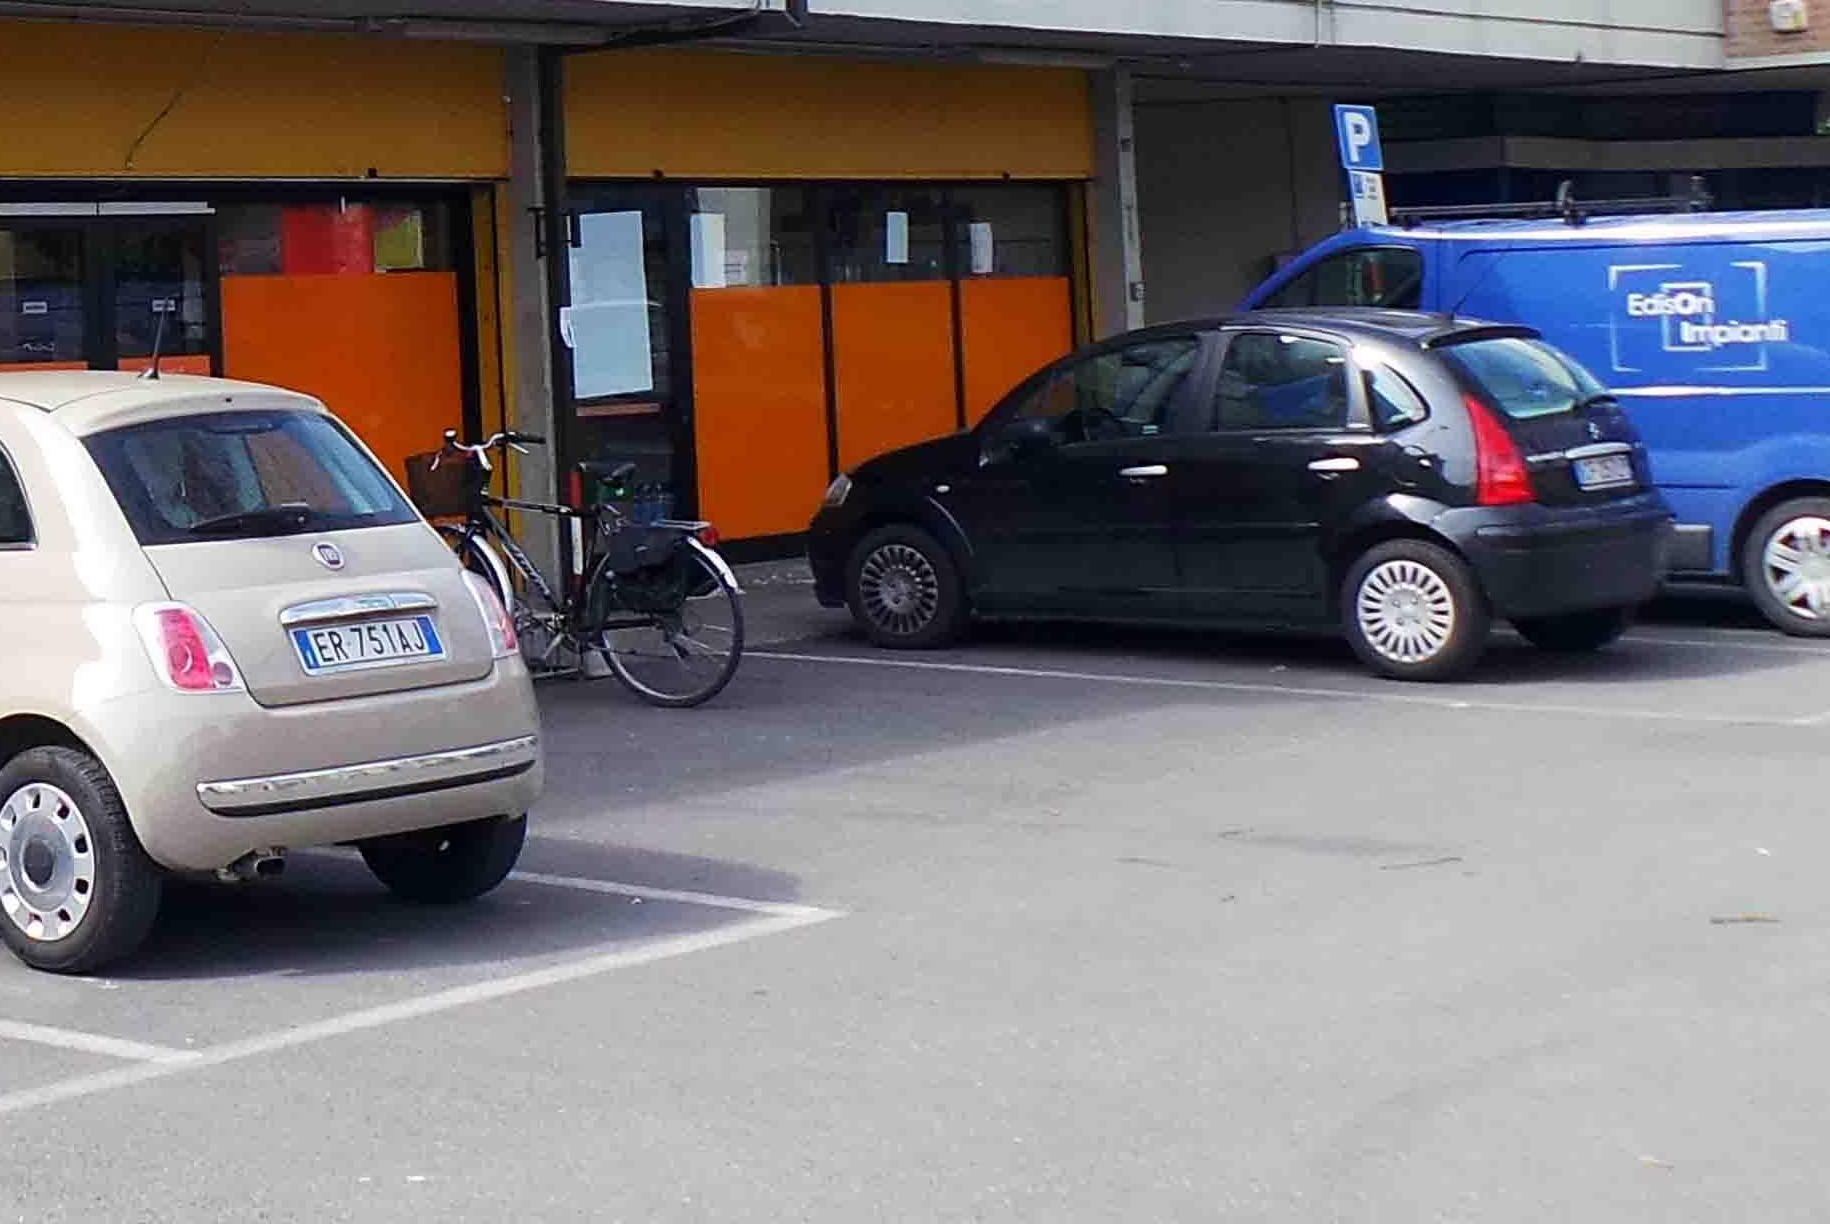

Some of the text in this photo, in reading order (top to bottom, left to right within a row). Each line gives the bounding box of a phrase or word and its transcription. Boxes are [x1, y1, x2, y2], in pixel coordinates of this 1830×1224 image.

[1343, 111, 1371, 163] P
[312, 622, 426, 663] ER 751AJ
